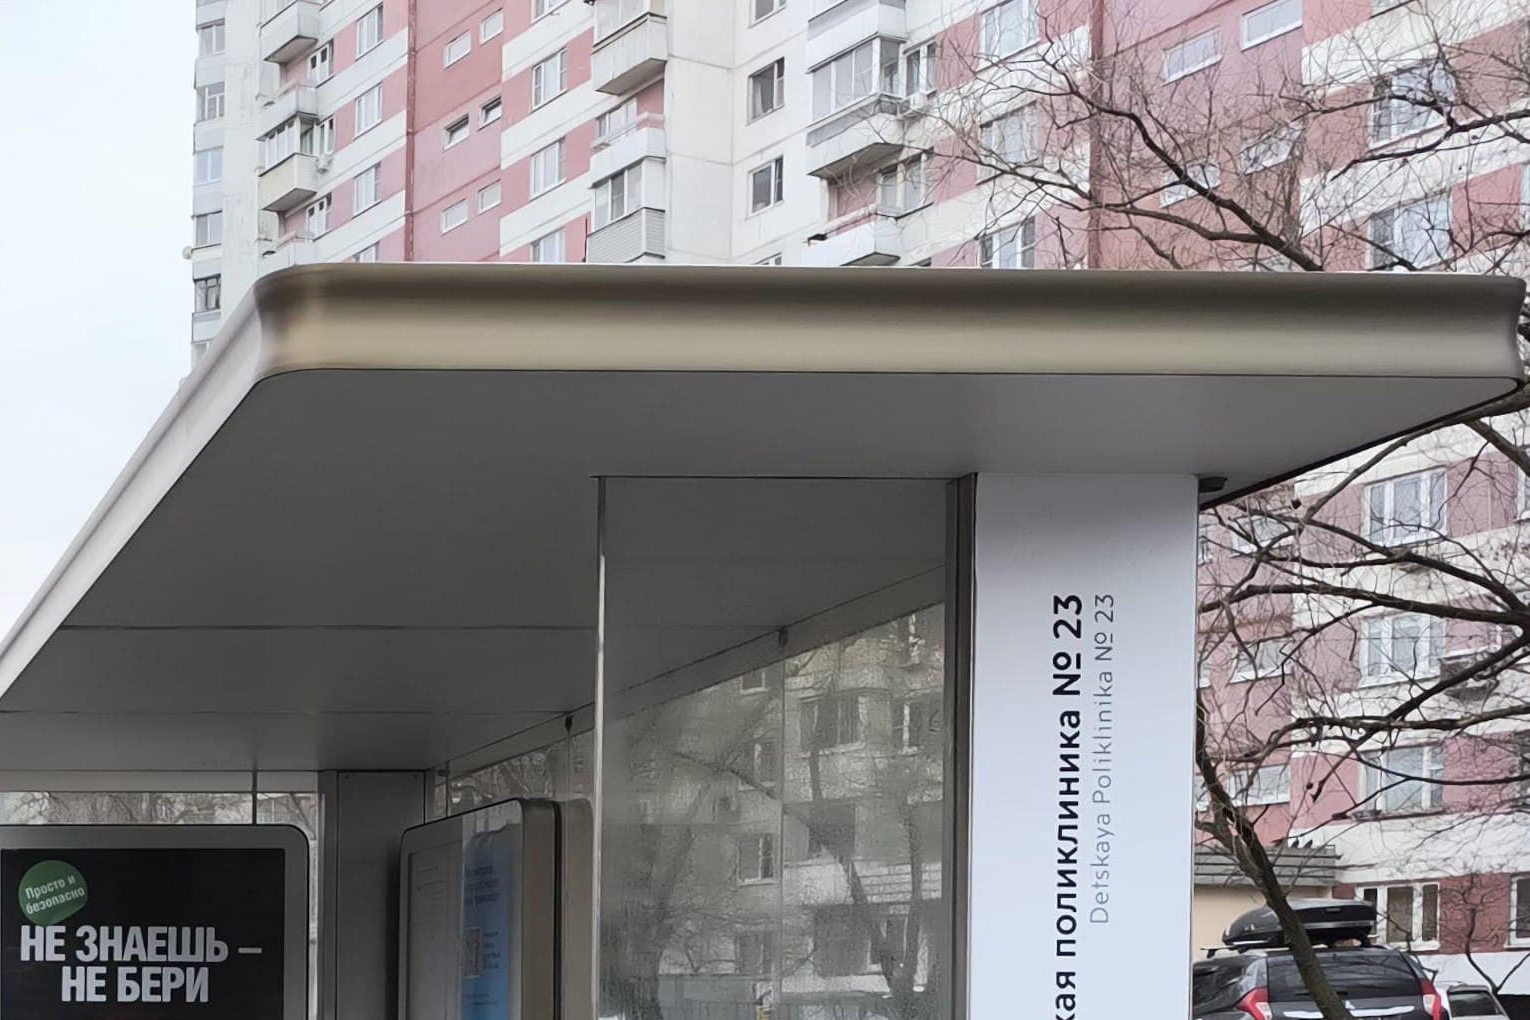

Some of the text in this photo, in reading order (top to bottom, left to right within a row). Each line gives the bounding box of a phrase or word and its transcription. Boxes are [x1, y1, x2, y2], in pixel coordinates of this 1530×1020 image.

[1053, 595, 1083, 640] 23
[1052, 651, 1082, 696] №
[1089, 594, 1115, 924] Detskaya Poliklinika № 23
[1056, 710, 1081, 957] поликлиника
[25, 879, 66, 899] Просто
[26, 887, 85, 914] безопасно
[21, 925, 66, 961] НЕ
[75, 925, 229, 962] ЗНАЕШЬ
[62, 966, 209, 1002] НЕ БЕРИ
